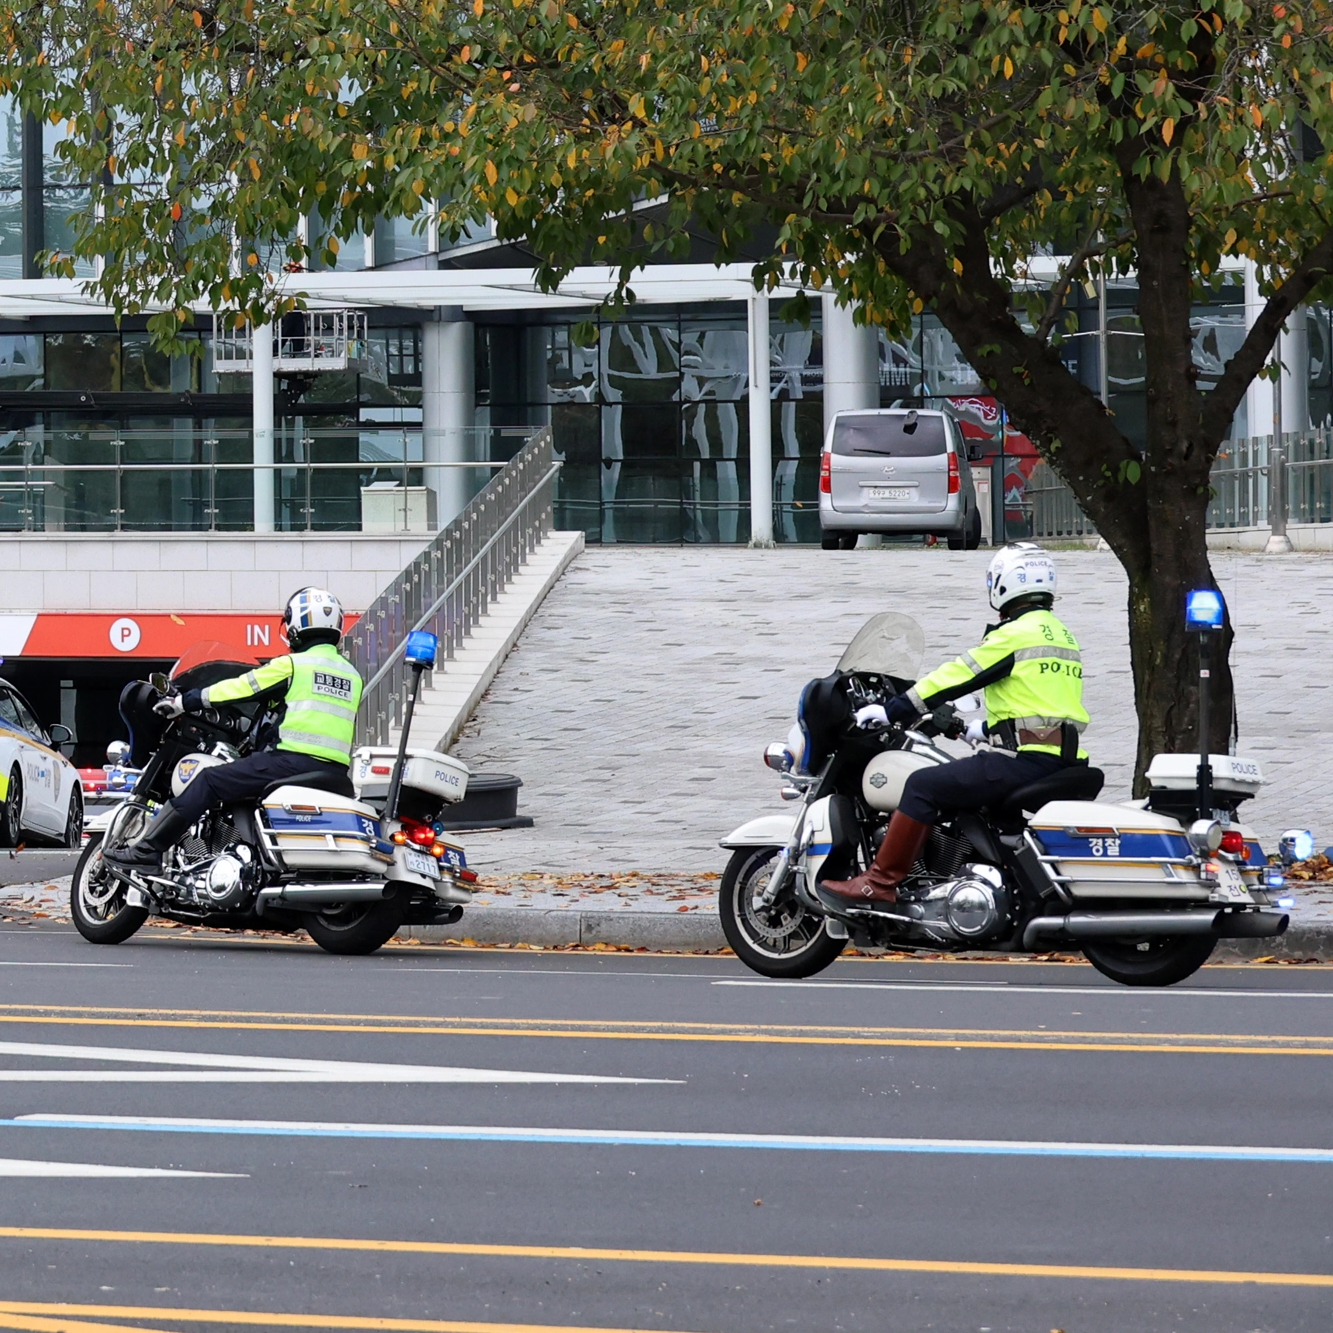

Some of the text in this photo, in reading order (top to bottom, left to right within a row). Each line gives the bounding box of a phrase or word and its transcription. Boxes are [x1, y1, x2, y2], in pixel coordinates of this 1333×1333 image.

[120, 627, 132, 643] P
[246, 624, 270, 646] IN
[316, 673, 351, 691] 교통경찰
[317, 685, 348, 698] POLICE
[1231, 762, 1258, 775] POLICE
[434, 770, 460, 787] POLICE
[1088, 838, 1121, 856] 경찰
[415, 859, 437, 875] 2717
